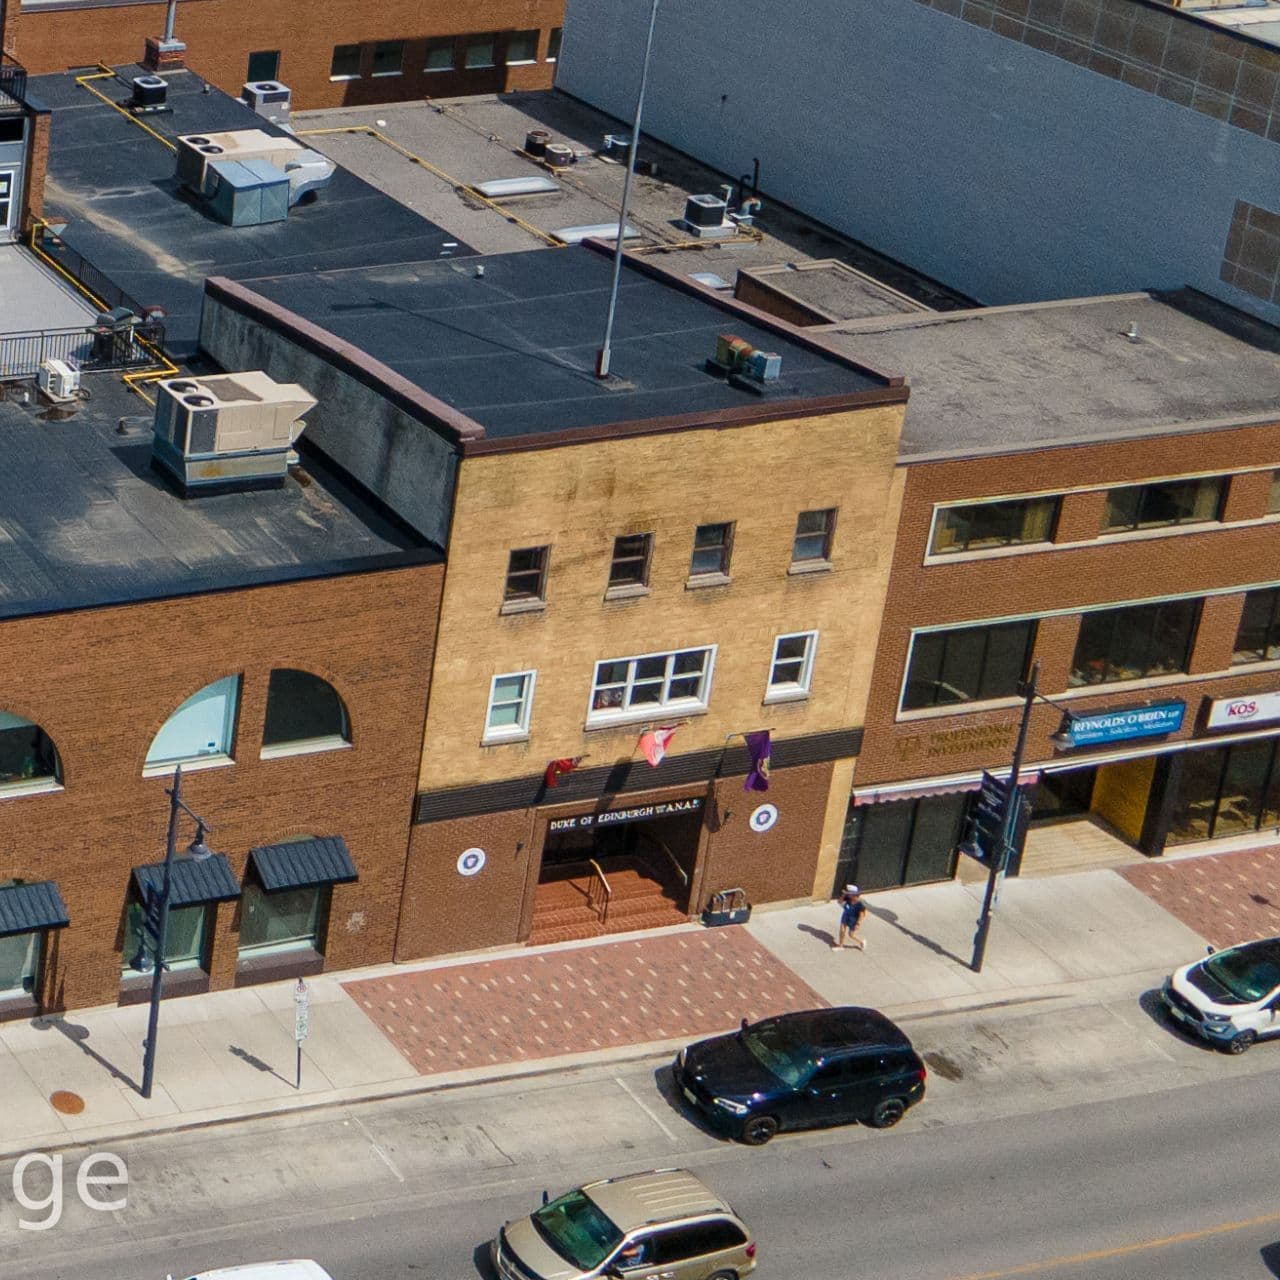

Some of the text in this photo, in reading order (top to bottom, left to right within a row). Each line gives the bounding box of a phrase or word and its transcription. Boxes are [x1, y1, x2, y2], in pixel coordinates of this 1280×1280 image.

[1227, 701, 1257, 717] KOS
[1073, 713, 1126, 732] REYNOLDS
[1127, 710, 1168, 726] O'BRIEN
[929, 722, 1013, 741] PROFESSIONAL
[550, 818, 576, 831] DUKE
[580, 815, 594, 826] OF
[597, 805, 654, 824] EDINBURGH
